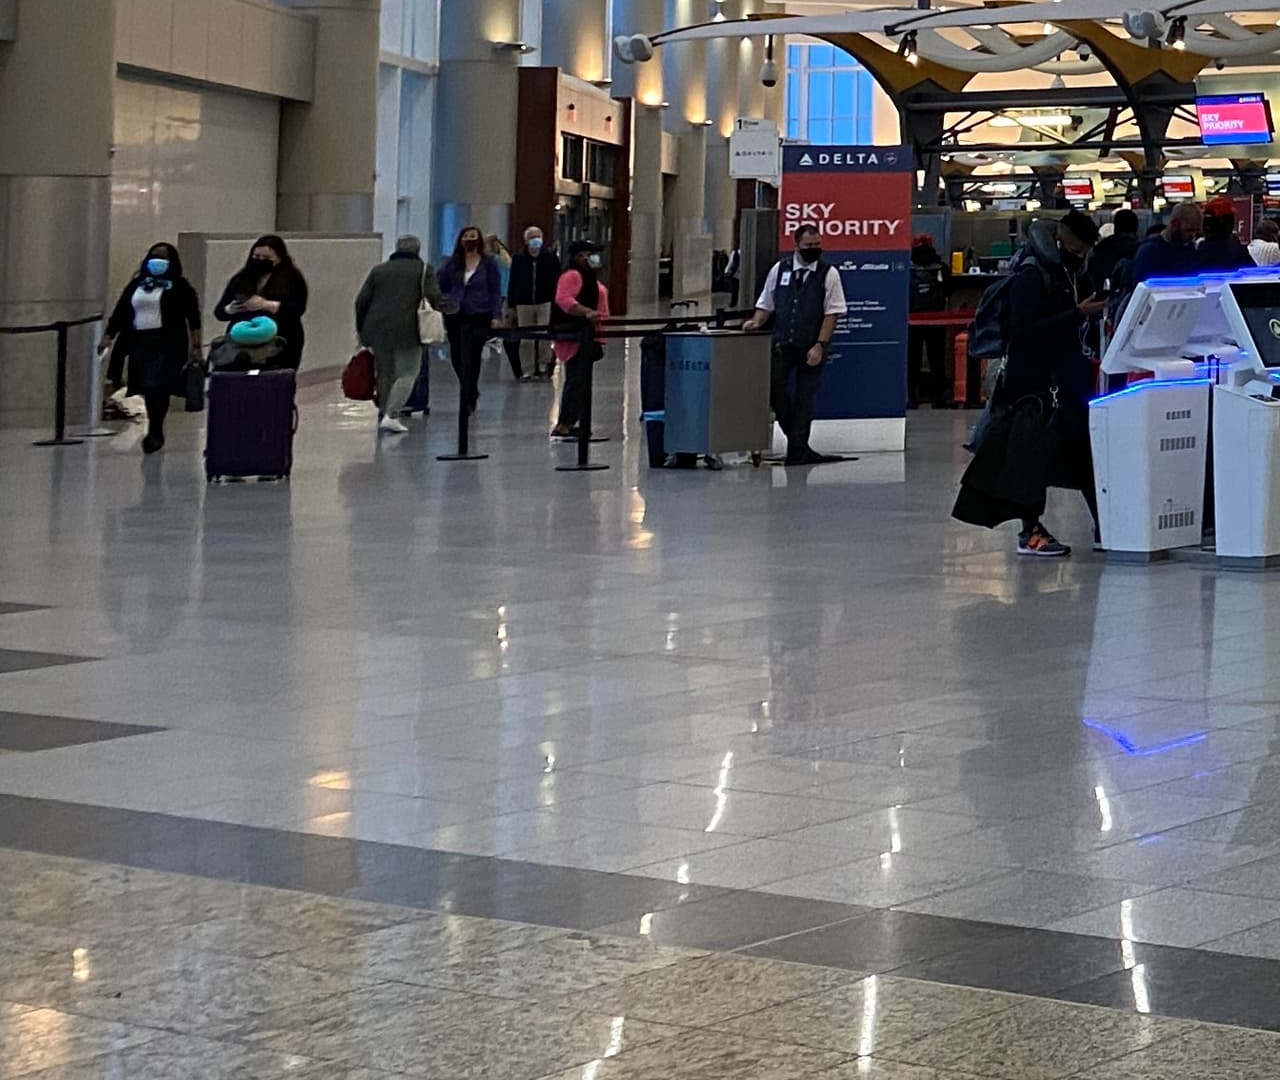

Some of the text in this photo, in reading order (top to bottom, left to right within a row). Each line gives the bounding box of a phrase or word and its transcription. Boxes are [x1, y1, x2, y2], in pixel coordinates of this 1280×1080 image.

[736, 119, 743, 130] 1
[818, 153, 879, 165] DELTA
[785, 202, 836, 219] SKY
[784, 220, 900, 236] PIORITY
